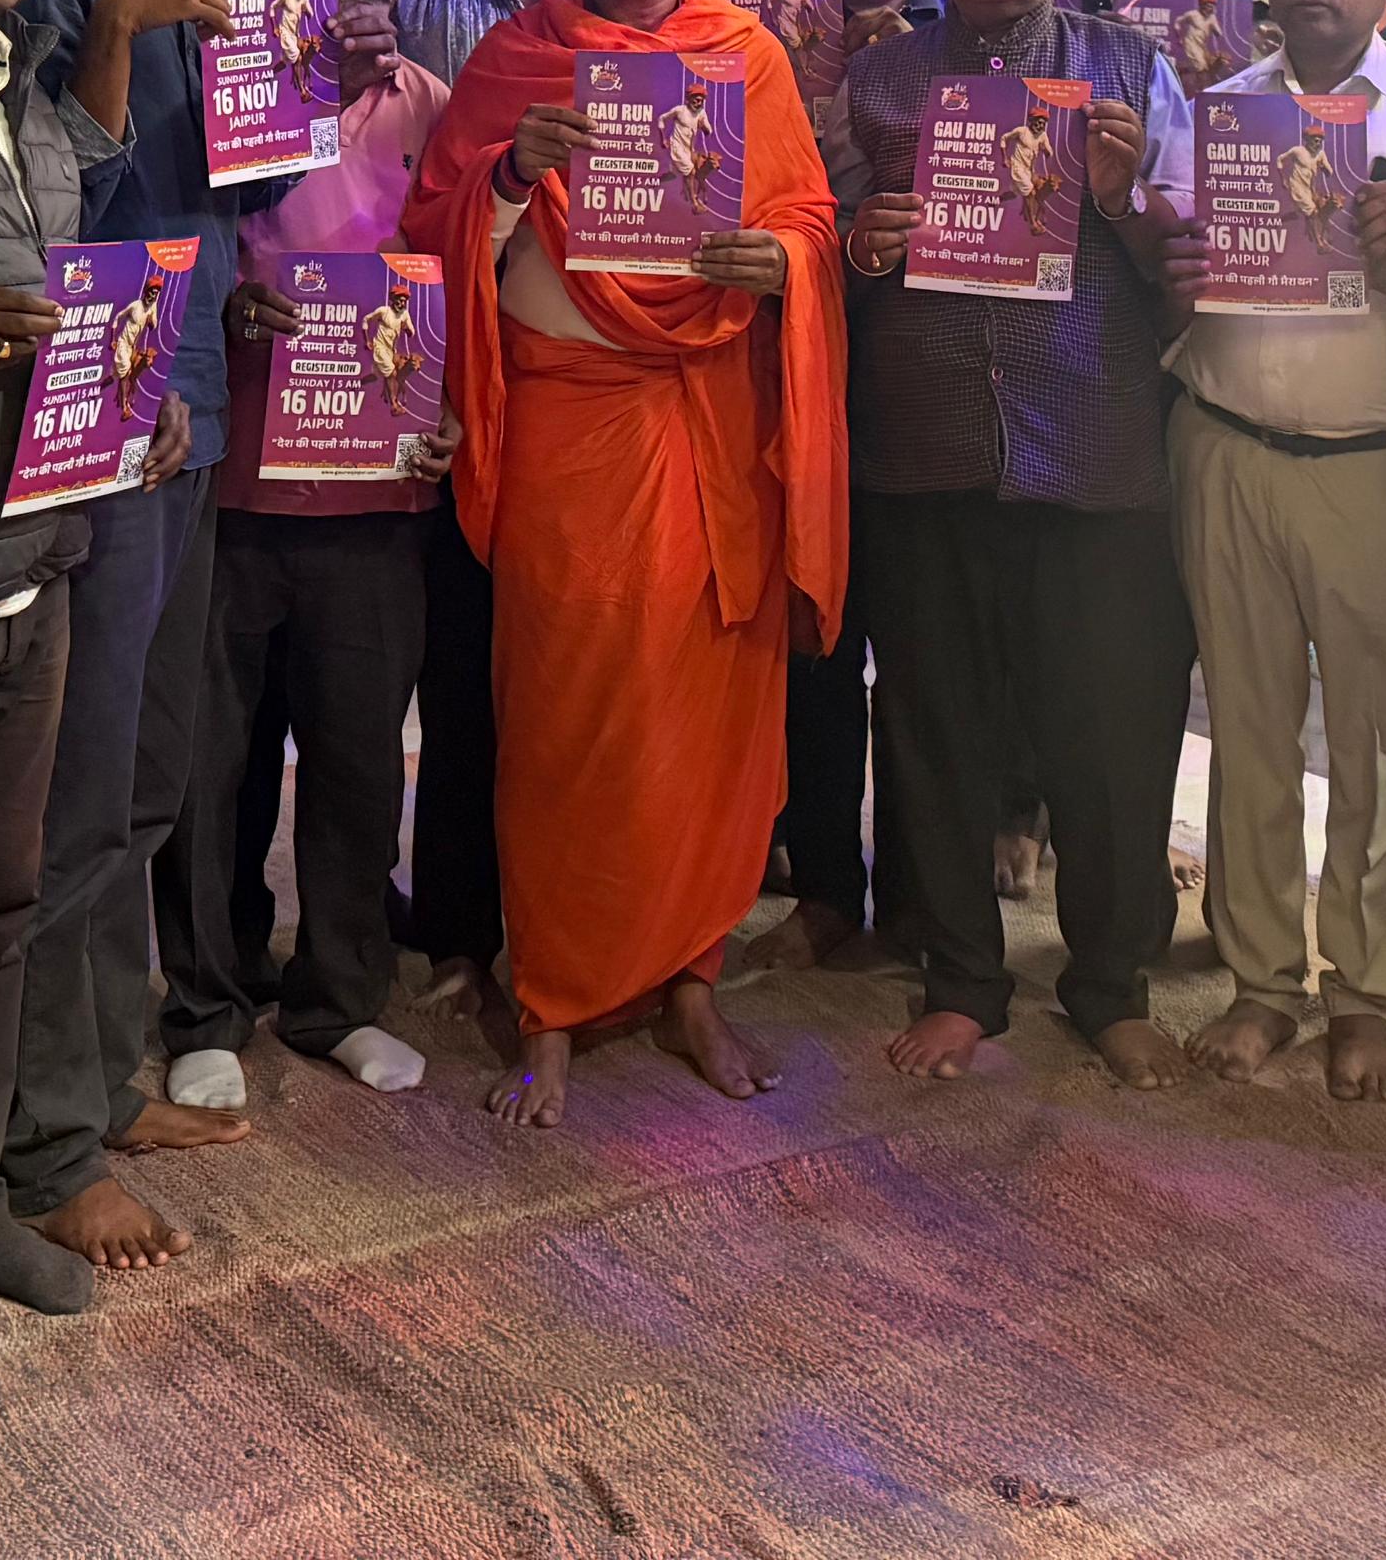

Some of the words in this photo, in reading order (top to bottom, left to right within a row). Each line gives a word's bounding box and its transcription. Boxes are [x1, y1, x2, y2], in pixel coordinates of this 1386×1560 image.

[213, 87, 234, 116] 16
[239, 81, 278, 112] NOV
[587, 102, 617, 120] GAU
[622, 104, 653, 122] RUN
[229, 113, 266, 132] JAIPUR
[934, 121, 962, 139] GAU
[966, 123, 996, 141] RUN
[1207, 143, 1236, 161] GAU
[1240, 144, 1270, 162] RUN
[581, 186, 606, 209] 16
[614, 189, 664, 212] NOV
[598, 213, 644, 226] JAIPUR
[924, 201, 948, 226] 16
[955, 205, 1004, 231] NOV
[939, 230, 984, 245] JAIPUR
[1206, 225, 1231, 251] 16
[1239, 229, 1287, 253] NOV
[1225, 253, 1270, 267] JAIPUR
[325, 305, 357, 323] RUN
[281, 389, 306, 415] 16
[314, 391, 364, 415] NOV
[33, 409, 55, 440] 16
[59, 398, 103, 434] NOV
[296, 418, 344, 431] JAIPUR
[42, 434, 82, 457] JAIPUR
